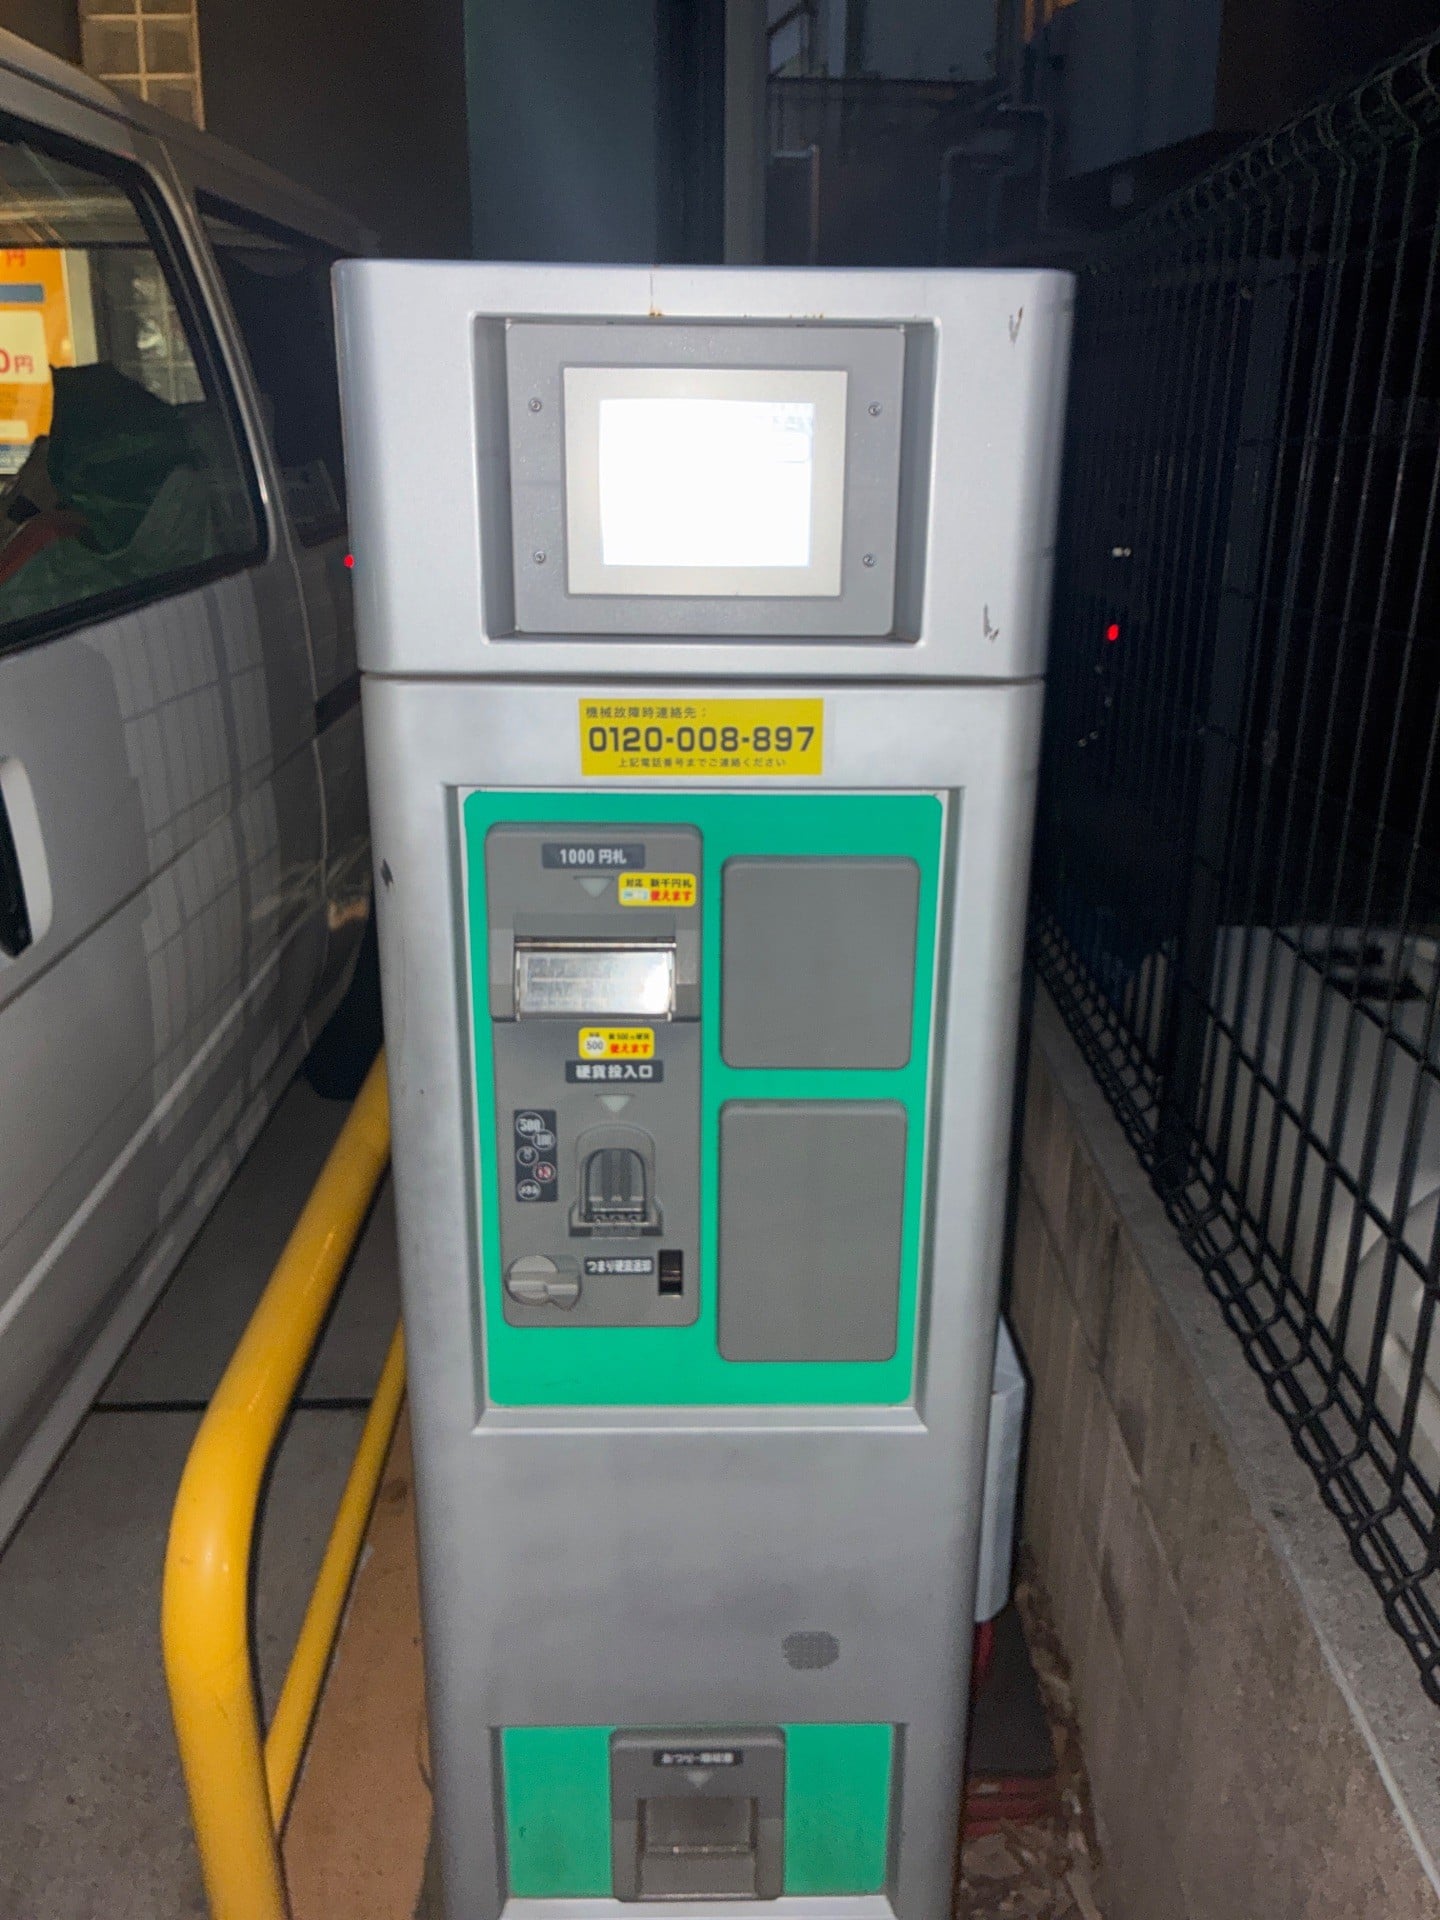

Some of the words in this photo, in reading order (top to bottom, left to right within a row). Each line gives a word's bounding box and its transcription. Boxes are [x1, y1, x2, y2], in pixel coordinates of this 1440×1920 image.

[589, 726, 815, 752] 0120-008-897
[575, 1064, 653, 1079] 硬貨投入口
